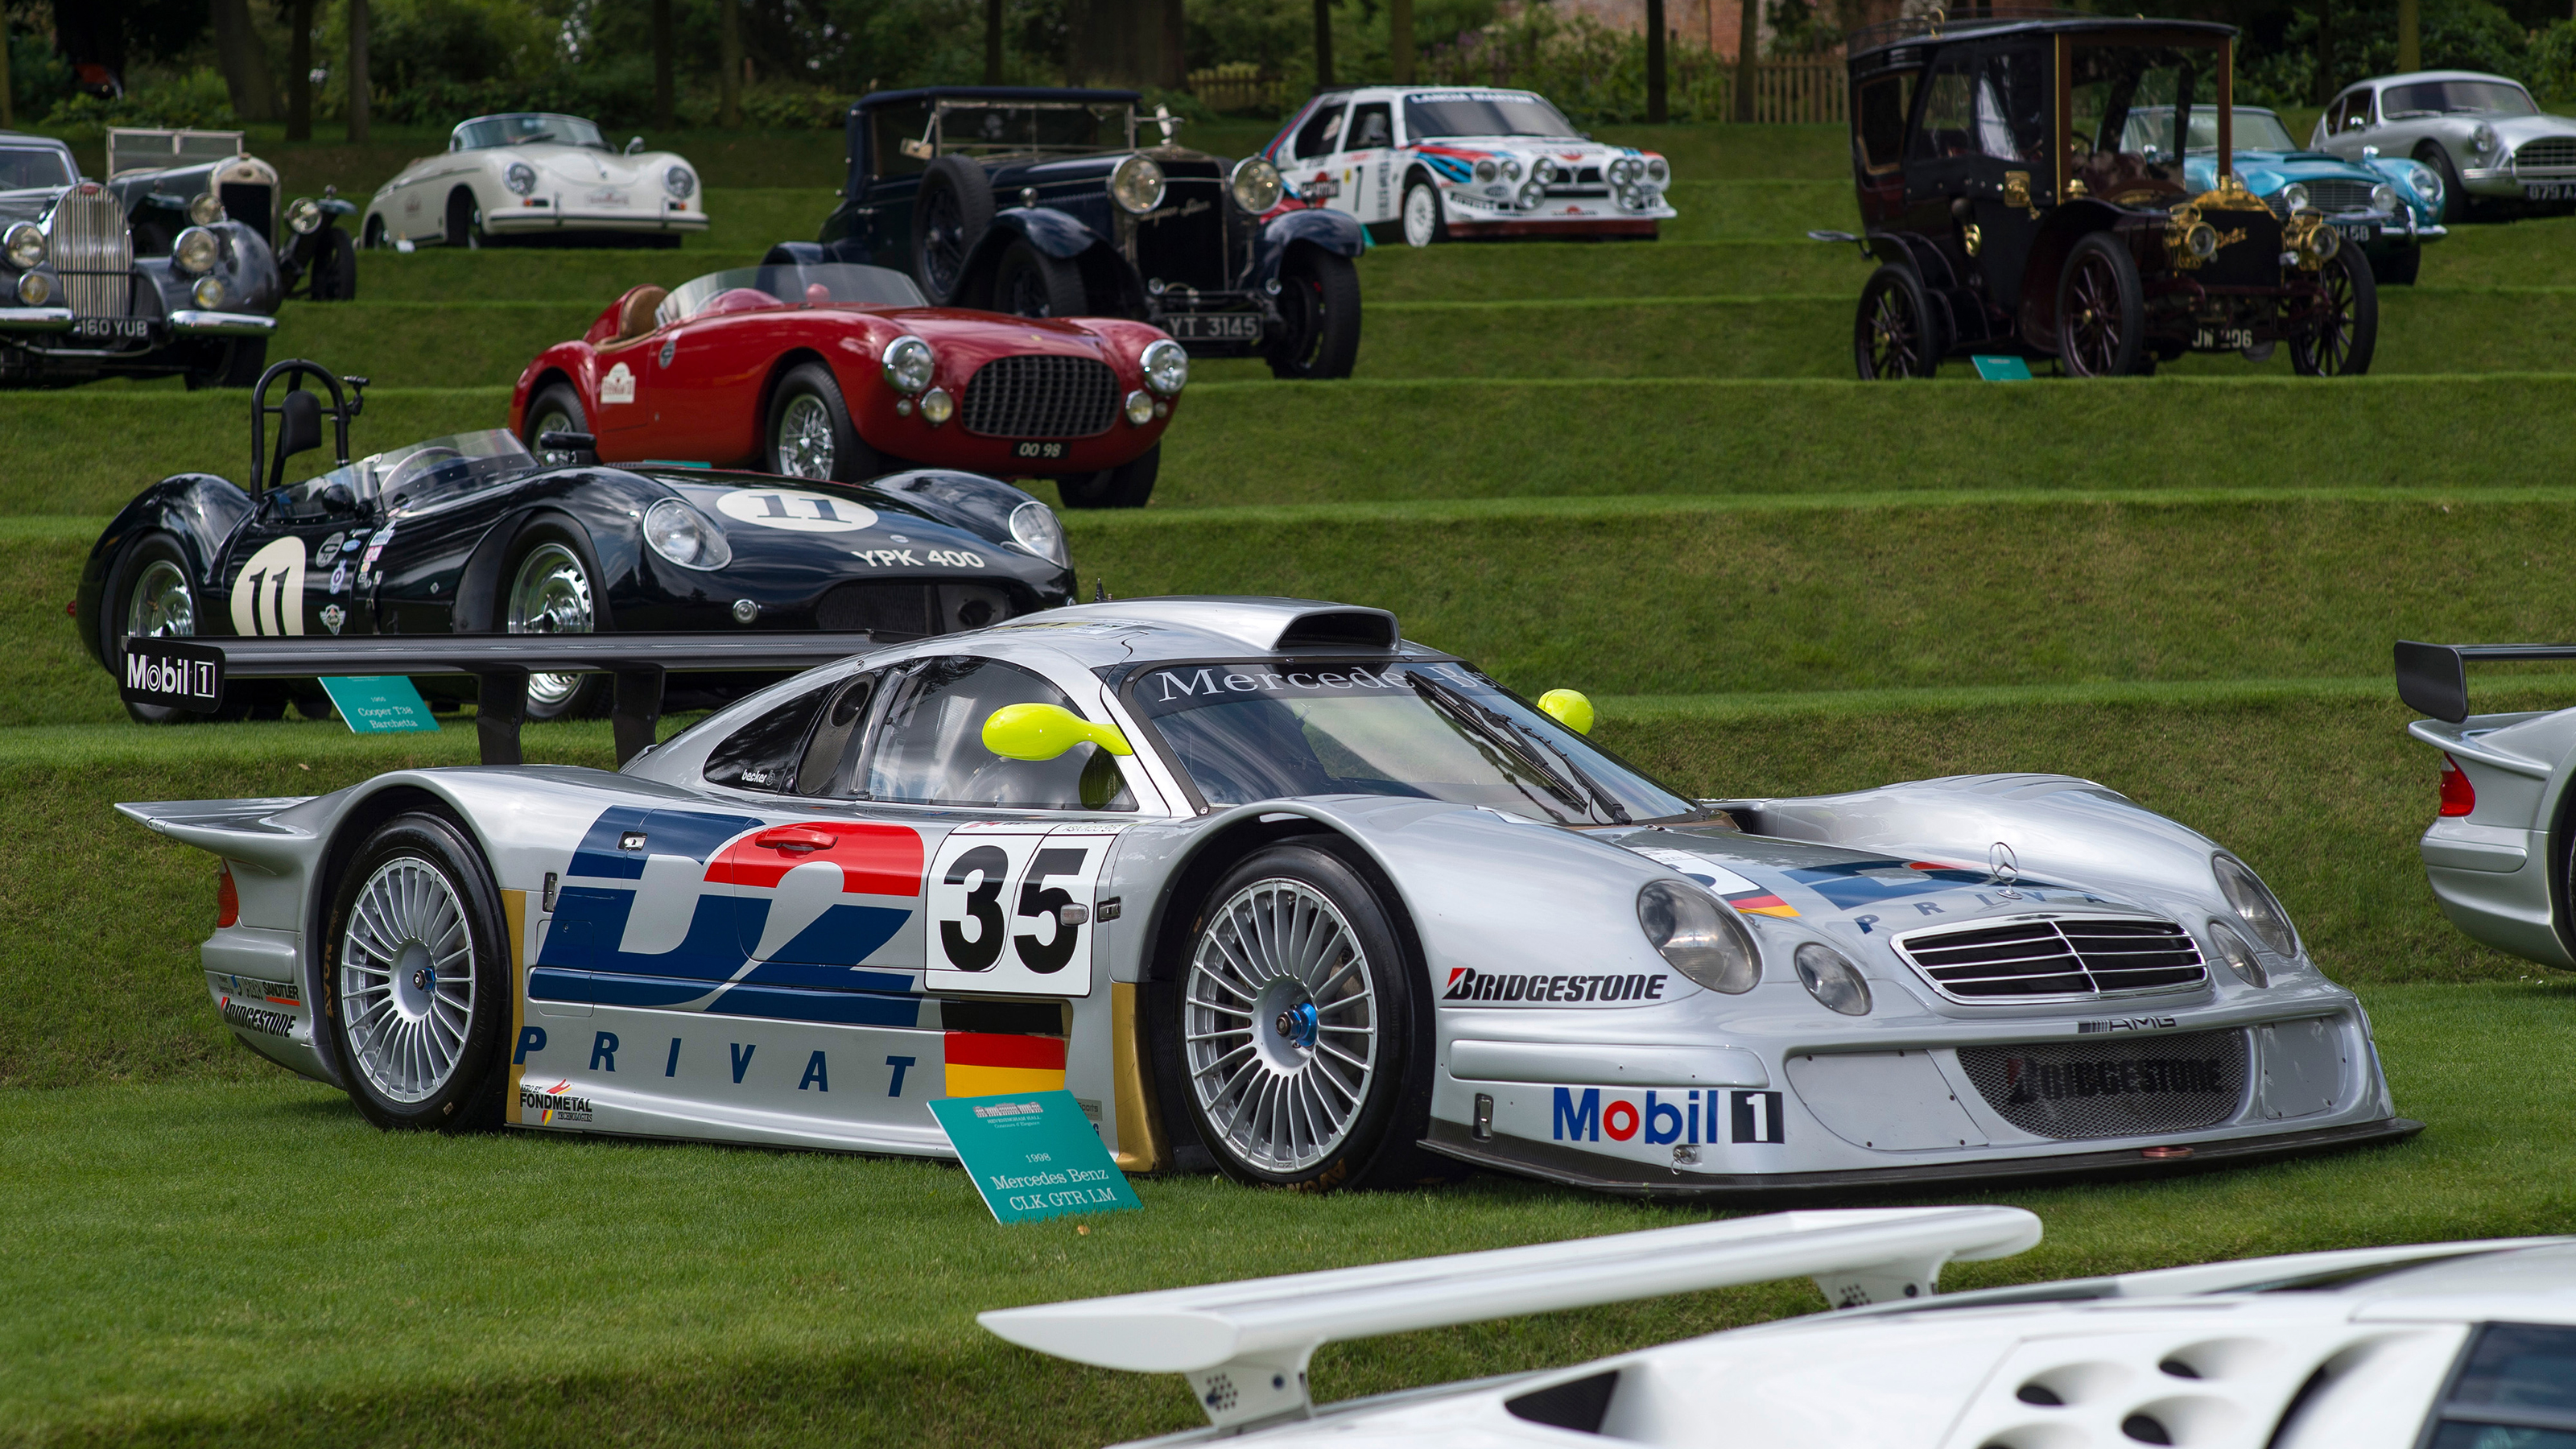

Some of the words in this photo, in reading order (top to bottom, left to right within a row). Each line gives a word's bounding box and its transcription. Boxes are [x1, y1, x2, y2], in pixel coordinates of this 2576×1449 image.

[81, 319, 110, 336] 160
[114, 320, 148, 337] YUB
[1168, 317, 1198, 336] YT
[1208, 317, 1258, 336] 3145
[1042, 444, 1063, 458] 98
[748, 495, 852, 524] 11
[851, 550, 923, 568] YPK
[927, 550, 986, 569] 400
[248, 566, 291, 637] 11
[127, 653, 189, 696] Mobil
[357, 706, 392, 718] Cooper
[392, 706, 414, 716] T38
[369, 718, 419, 729] Barchetta
[741, 769, 767, 783] becker
[939, 844, 1089, 975] 35
[262, 980, 299, 1001] SANDTLER
[1442, 968, 1668, 1001] BRIDGESTONE
[221, 997, 297, 1038] BRIDGESTONE
[2108, 1016, 2178, 1032] AMG
[512, 1026, 916, 1098] PRIVAT
[519, 1092, 592, 1113] FONDMETAL
[557, 1111, 593, 1122] TECHNOLOGIES
[1553, 1087, 1719, 1145] Mobil
[1025, 1152, 1051, 1163] 1998
[989, 1171, 1067, 1191] Mercedes
[1066, 1167, 1109, 1183] Benz
[1009, 1194, 1049, 1212] CLK
[1048, 1191, 1088, 1208] GTR
[1087, 1187, 1118, 1203] LM
